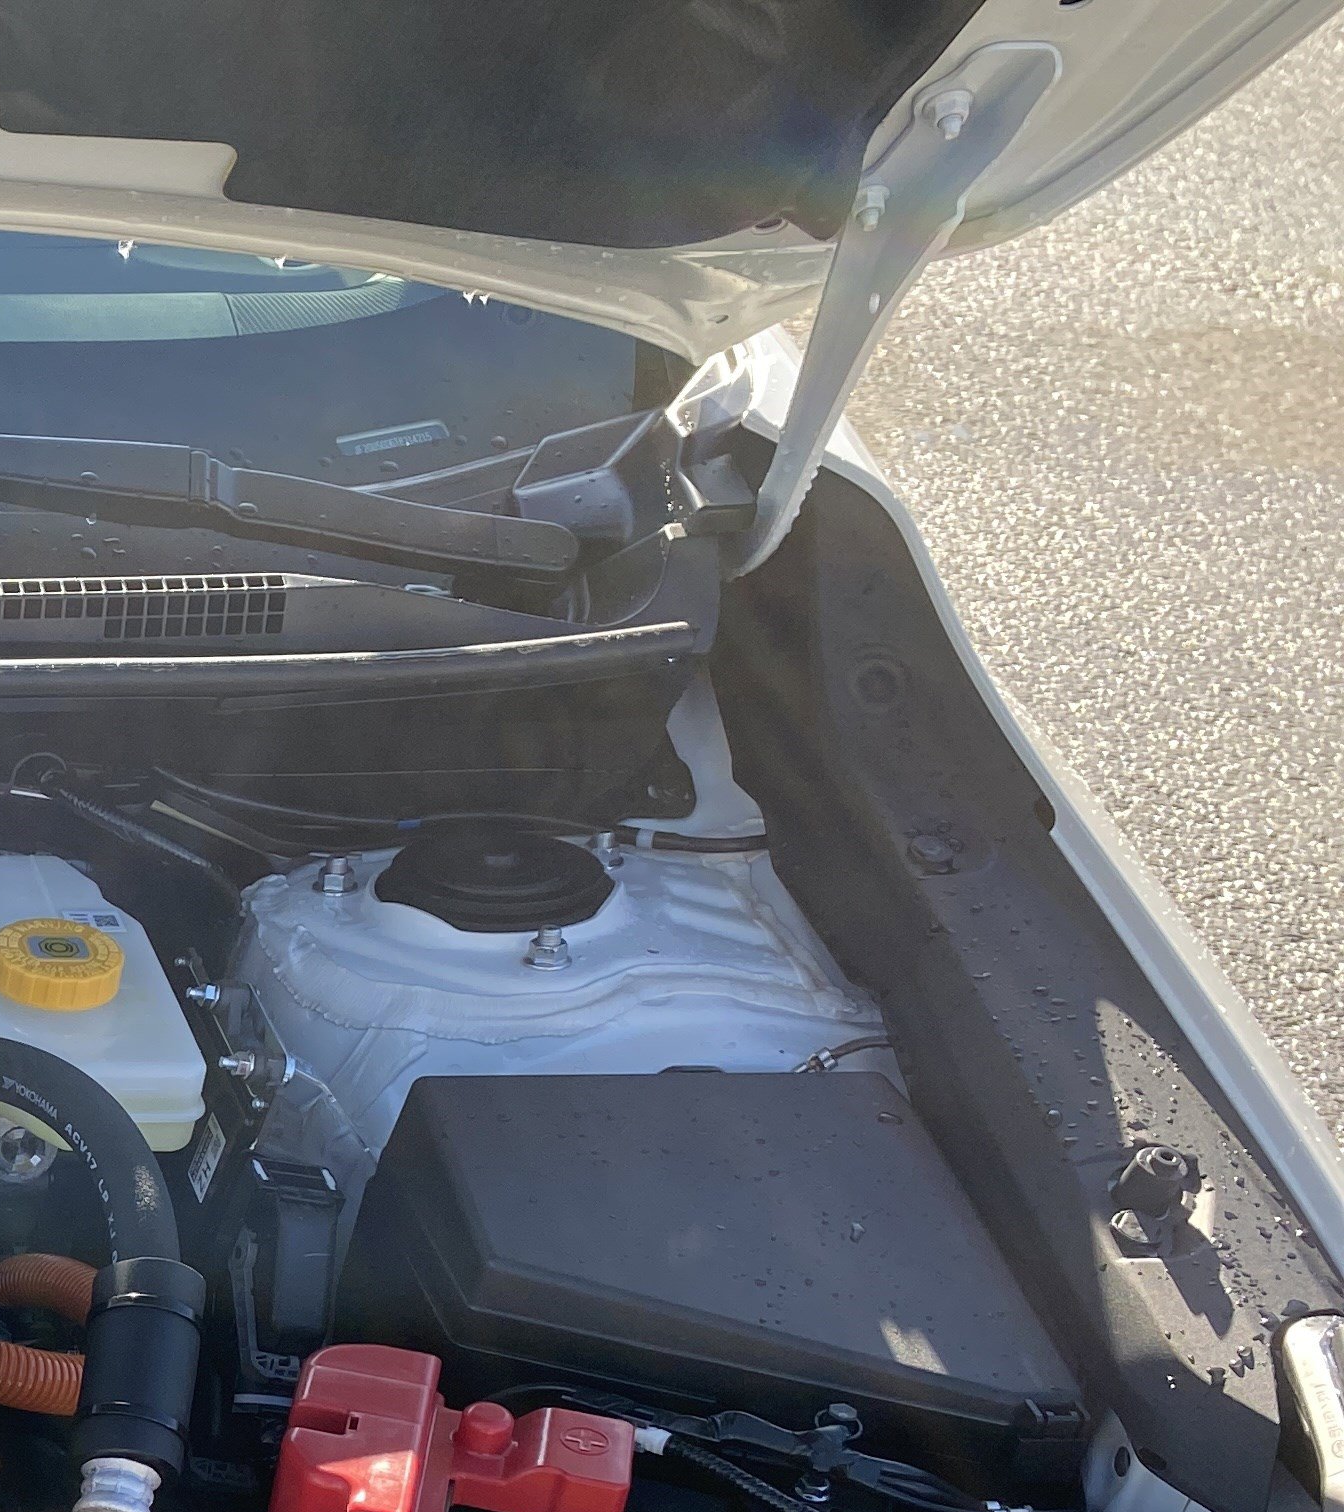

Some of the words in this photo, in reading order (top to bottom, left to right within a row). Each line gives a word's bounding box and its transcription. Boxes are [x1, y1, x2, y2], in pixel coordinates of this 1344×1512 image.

[15, 919, 85, 933] WARNING
[13, 1080, 58, 1121] YOKOHAMA
[64, 1123, 98, 1170] ACV17
